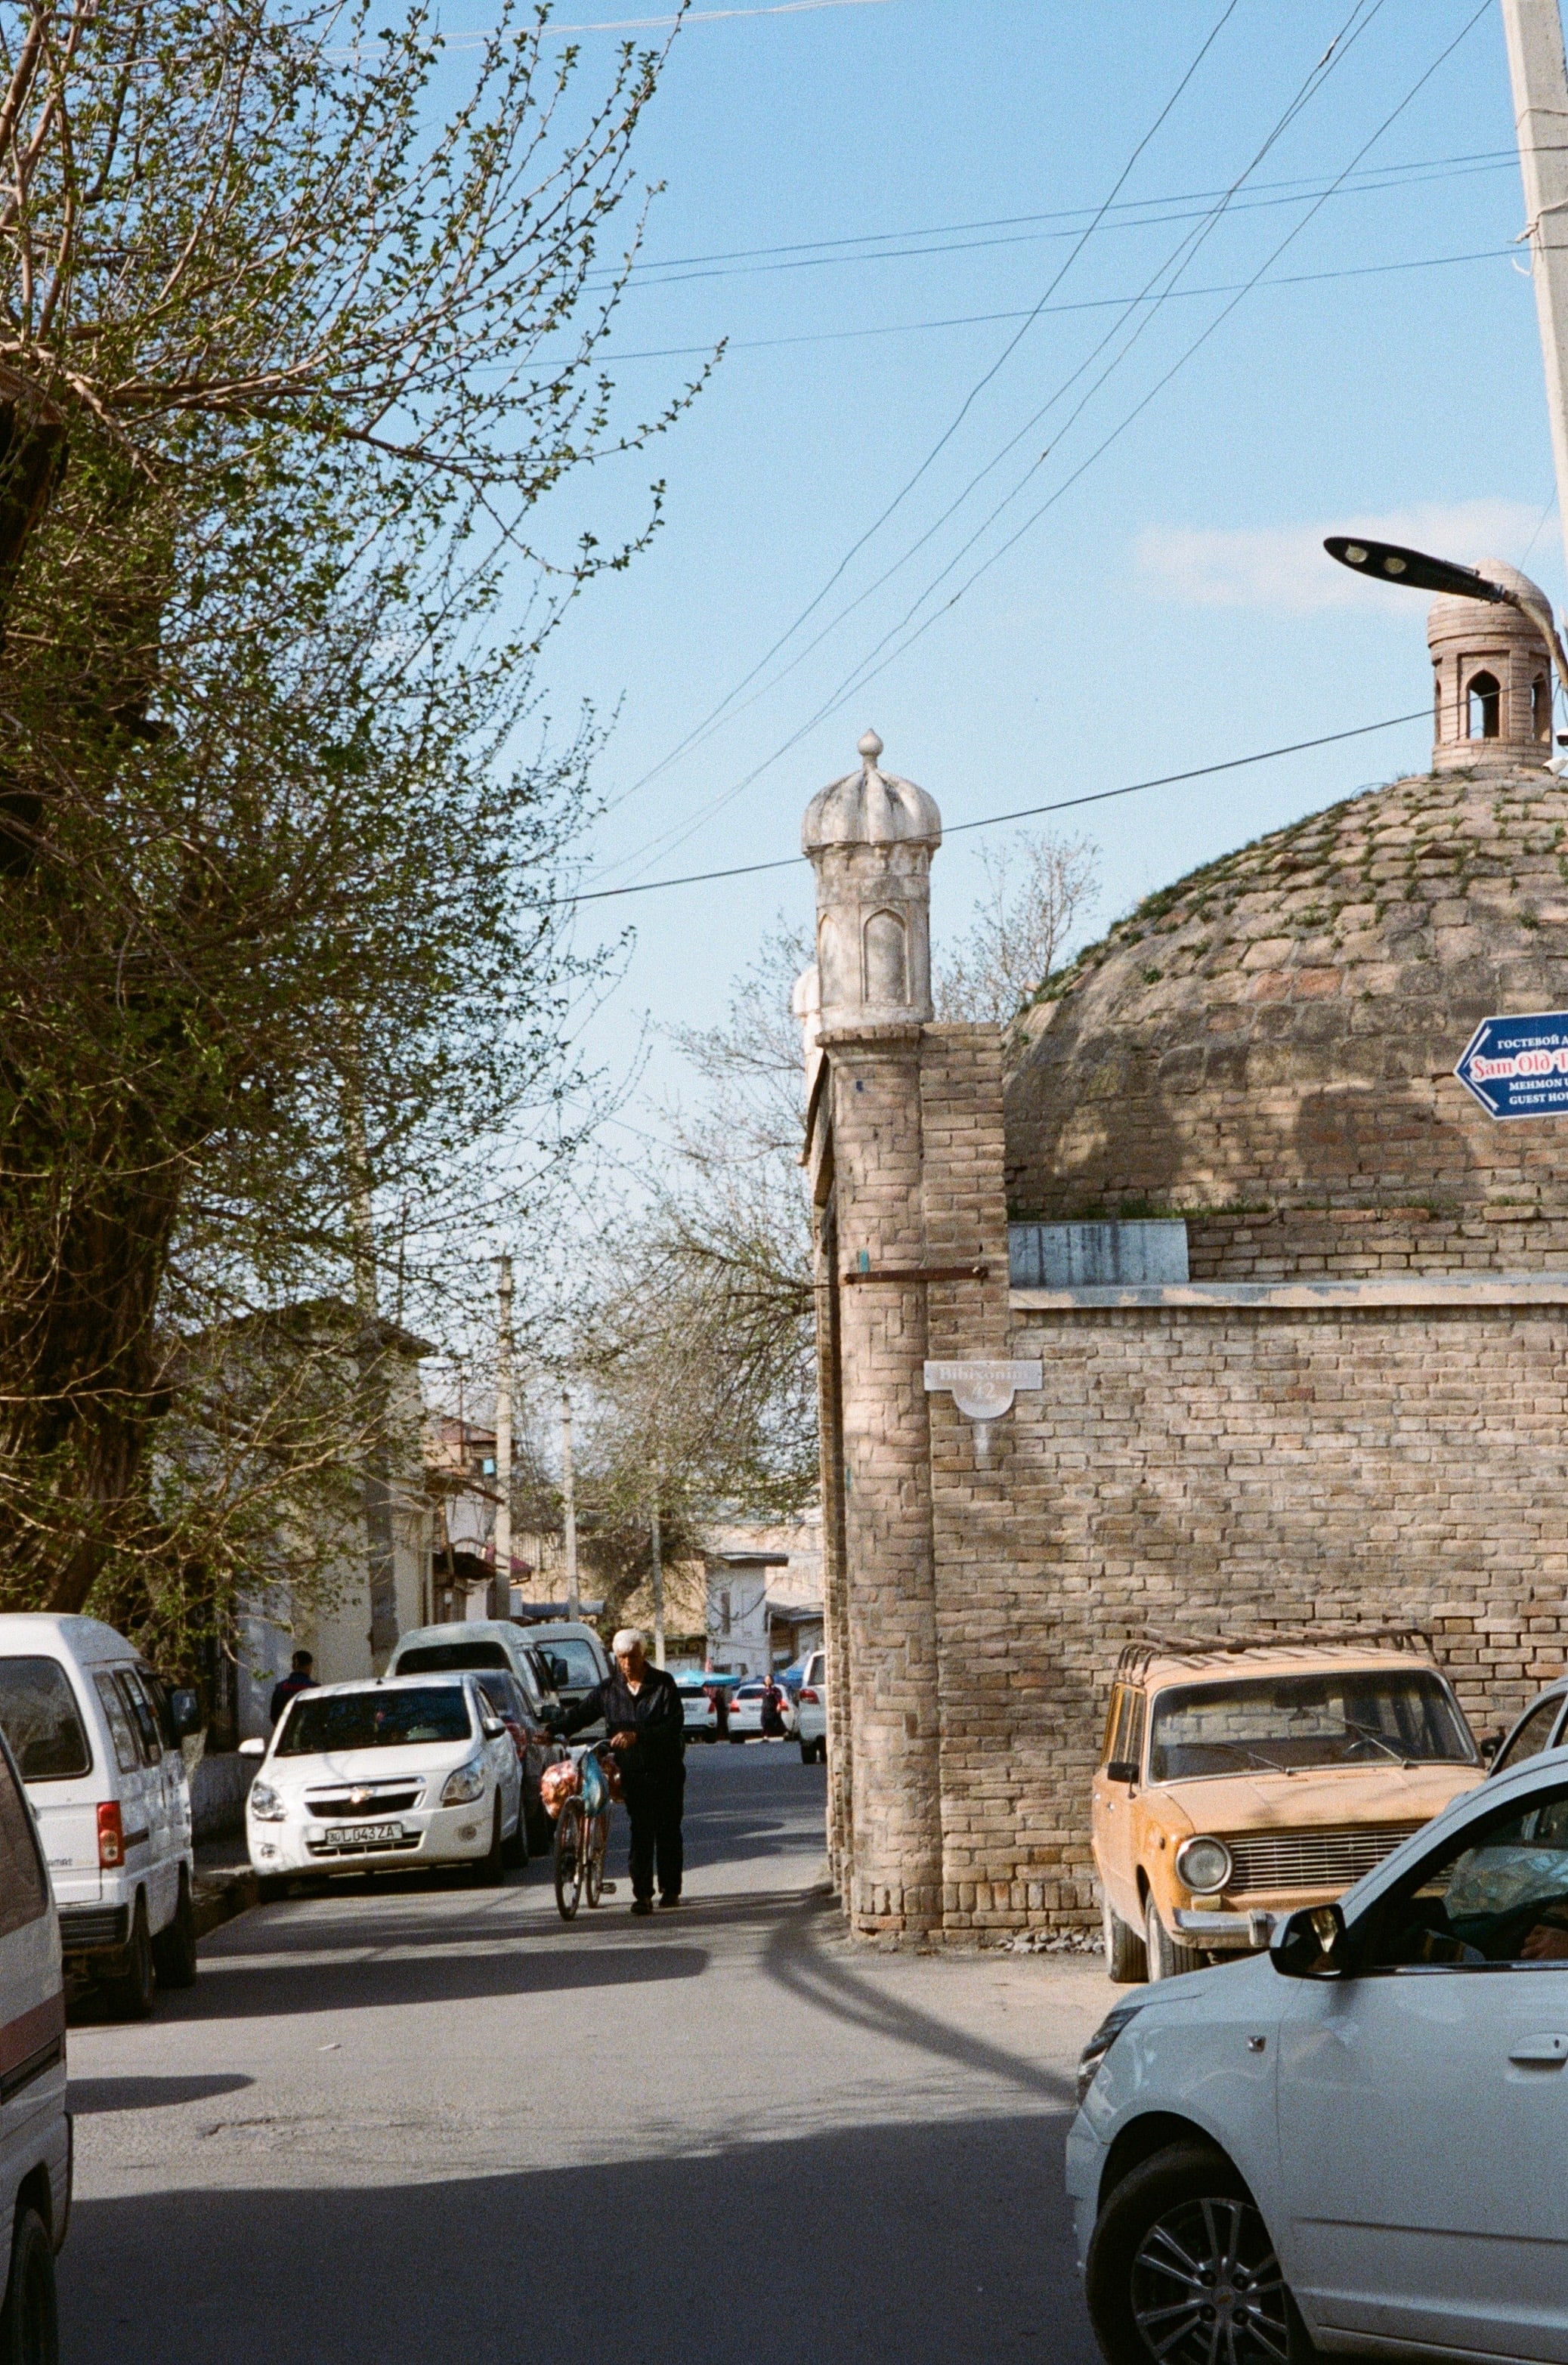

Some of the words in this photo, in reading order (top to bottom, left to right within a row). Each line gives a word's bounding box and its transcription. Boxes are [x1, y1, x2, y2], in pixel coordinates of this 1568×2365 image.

[1497, 1034, 1560, 1049] ГОСТЕВОЙ
[1474, 1059, 1513, 1079] Sam
[1518, 1053, 1550, 1073] Old
[1509, 1077, 1562, 1091] MEHMON
[1509, 1093, 1546, 1105] GUEST
